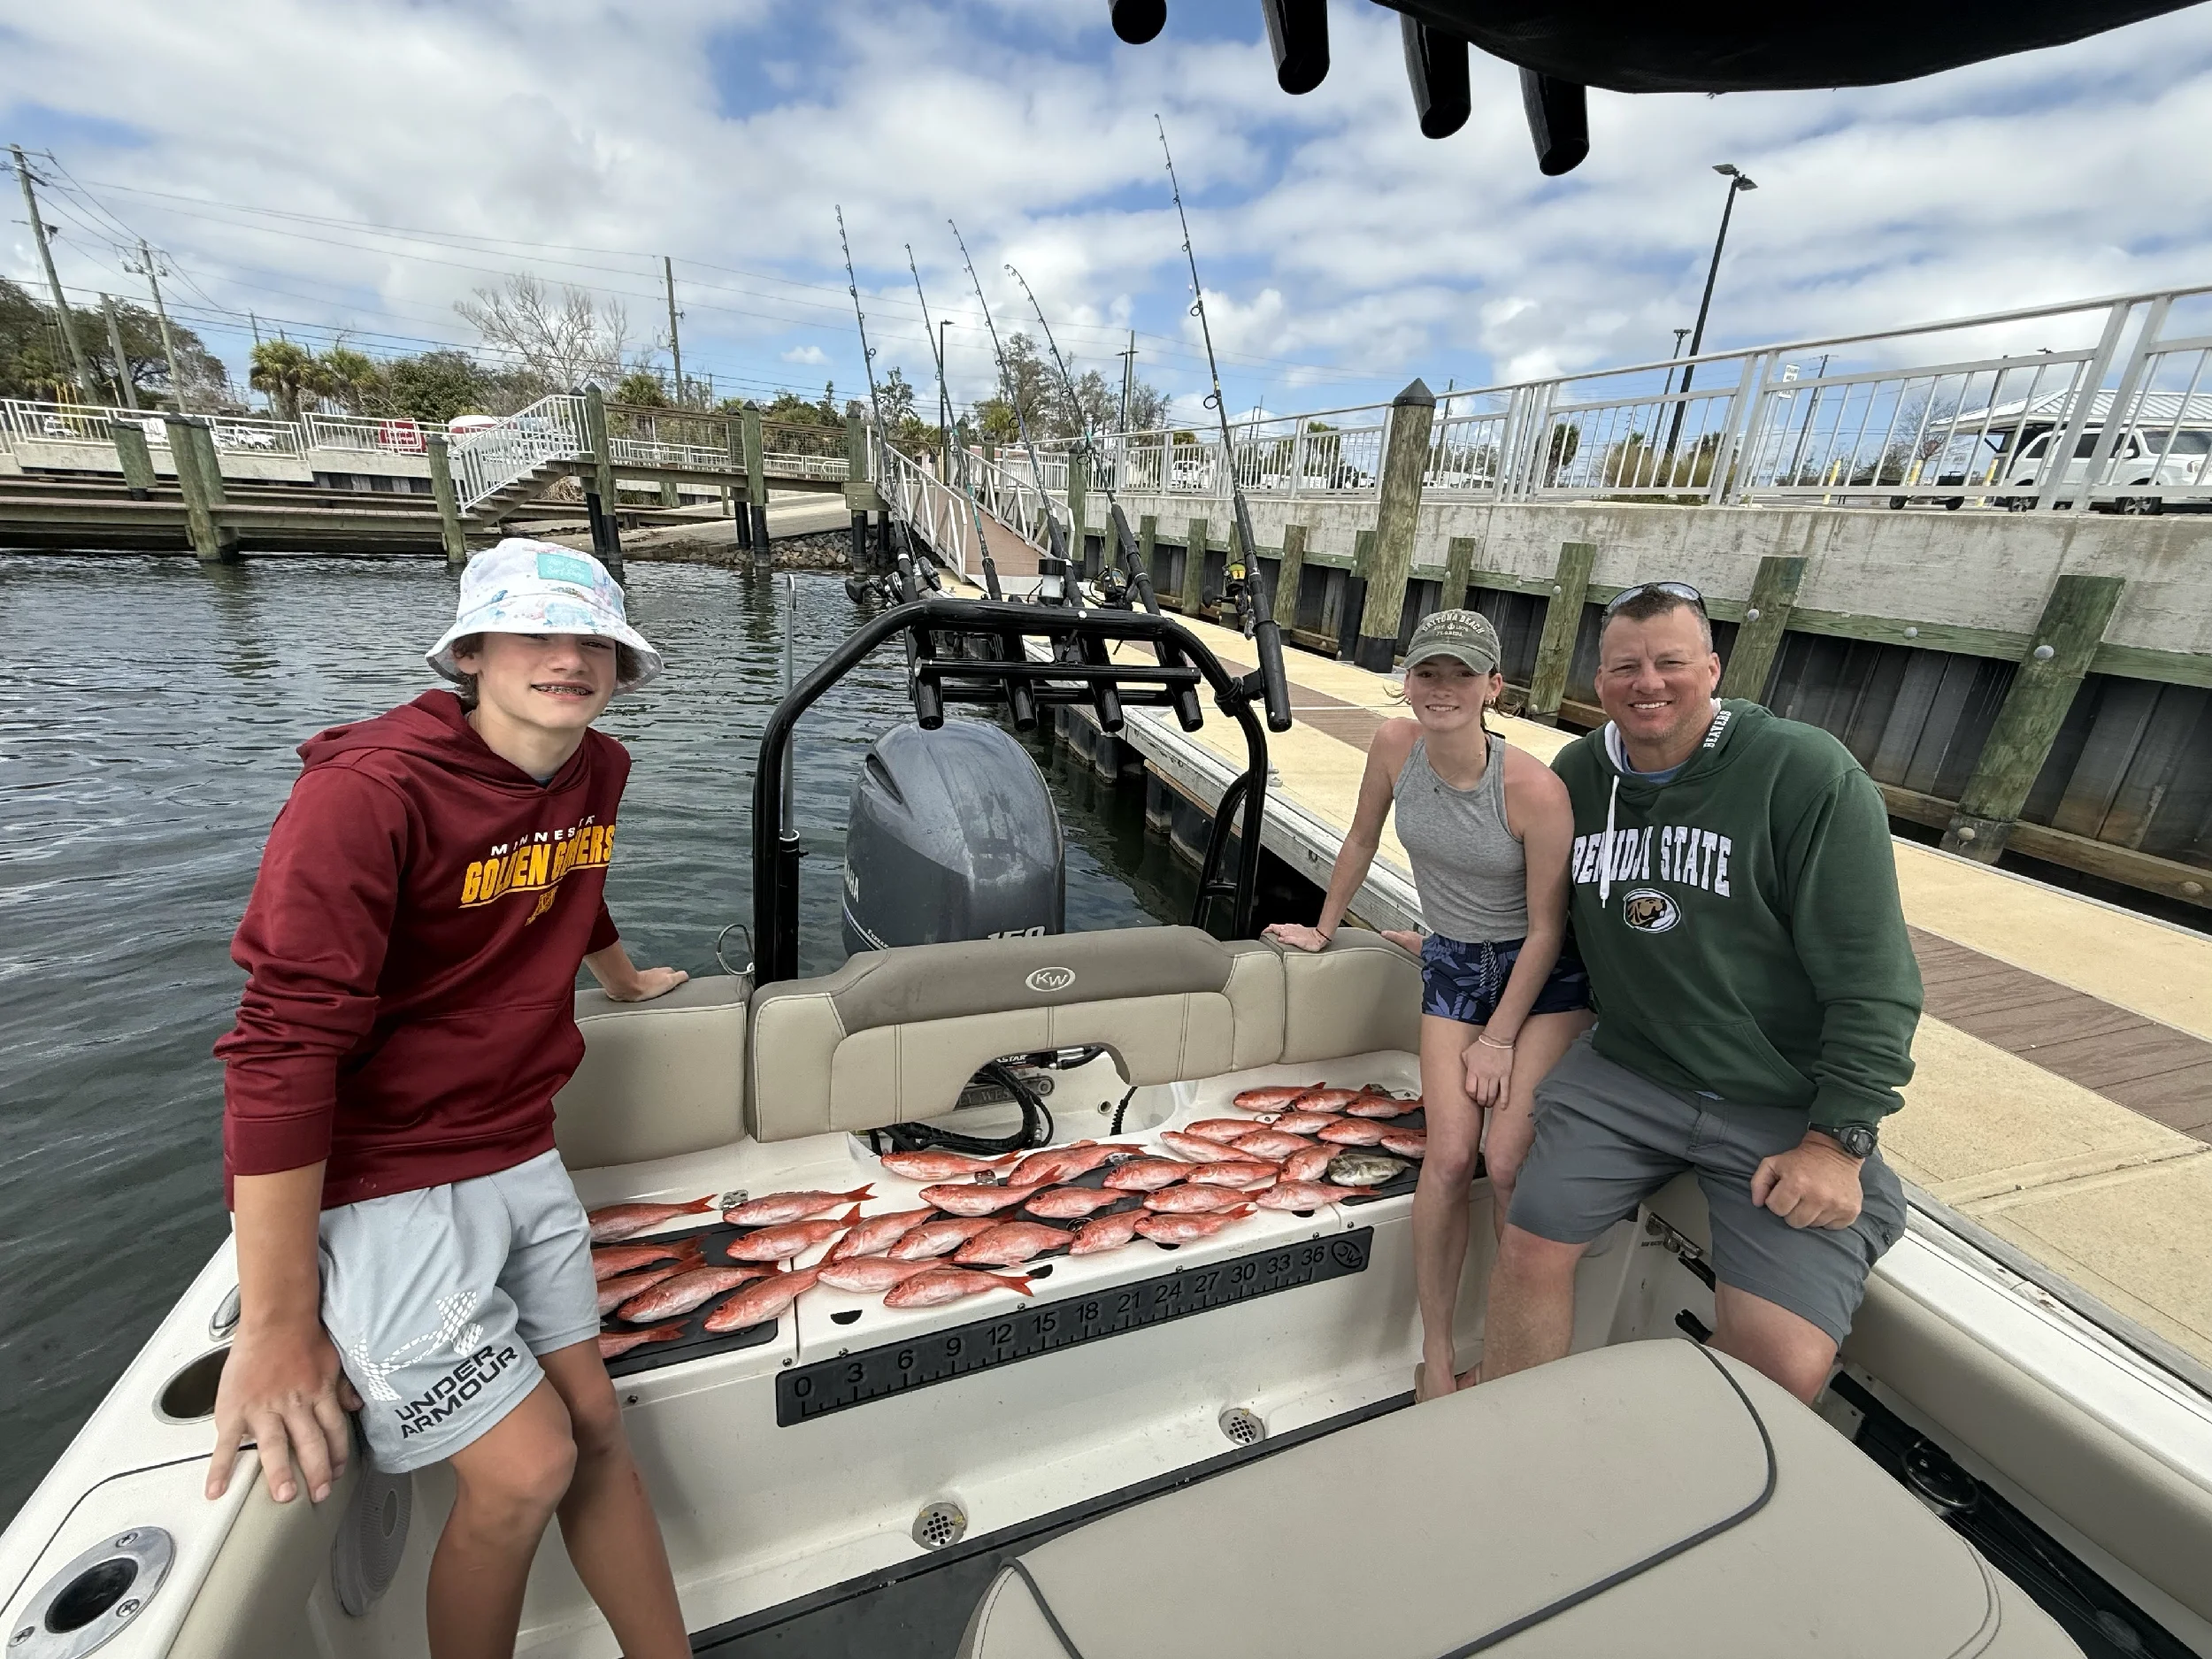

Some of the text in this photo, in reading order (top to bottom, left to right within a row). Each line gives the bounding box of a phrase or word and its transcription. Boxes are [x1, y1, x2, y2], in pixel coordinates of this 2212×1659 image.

[1422, 613, 1486, 634] DAYTONA BEACH
[1703, 710, 1732, 749] BEAVERS
[491, 815, 595, 856] MINNESTA
[461, 844, 551, 903] GOLDEN
[1660, 826, 1732, 898] STATE
[1036, 972, 1068, 987] KW
[981, 1089, 1009, 1102] WES
[795, 1377, 811, 1397] 0
[848, 1363, 864, 1383] 3
[897, 1349, 914, 1370] 6
[946, 1337, 962, 1357] 9
[987, 1323, 1012, 1346] 12
[1033, 1311, 1056, 1334] 15
[1077, 1301, 1099, 1323] 18
[1118, 1291, 1140, 1314] 21
[1156, 1280, 1182, 1304] 24
[1194, 1271, 1220, 1294] 27
[1231, 1262, 1256, 1284] 30
[1266, 1254, 1291, 1275] 33
[1301, 1246, 1325, 1266] 36
[395, 1345, 496, 1421] UNDER
[401, 1347, 518, 1439] ARMOUR
